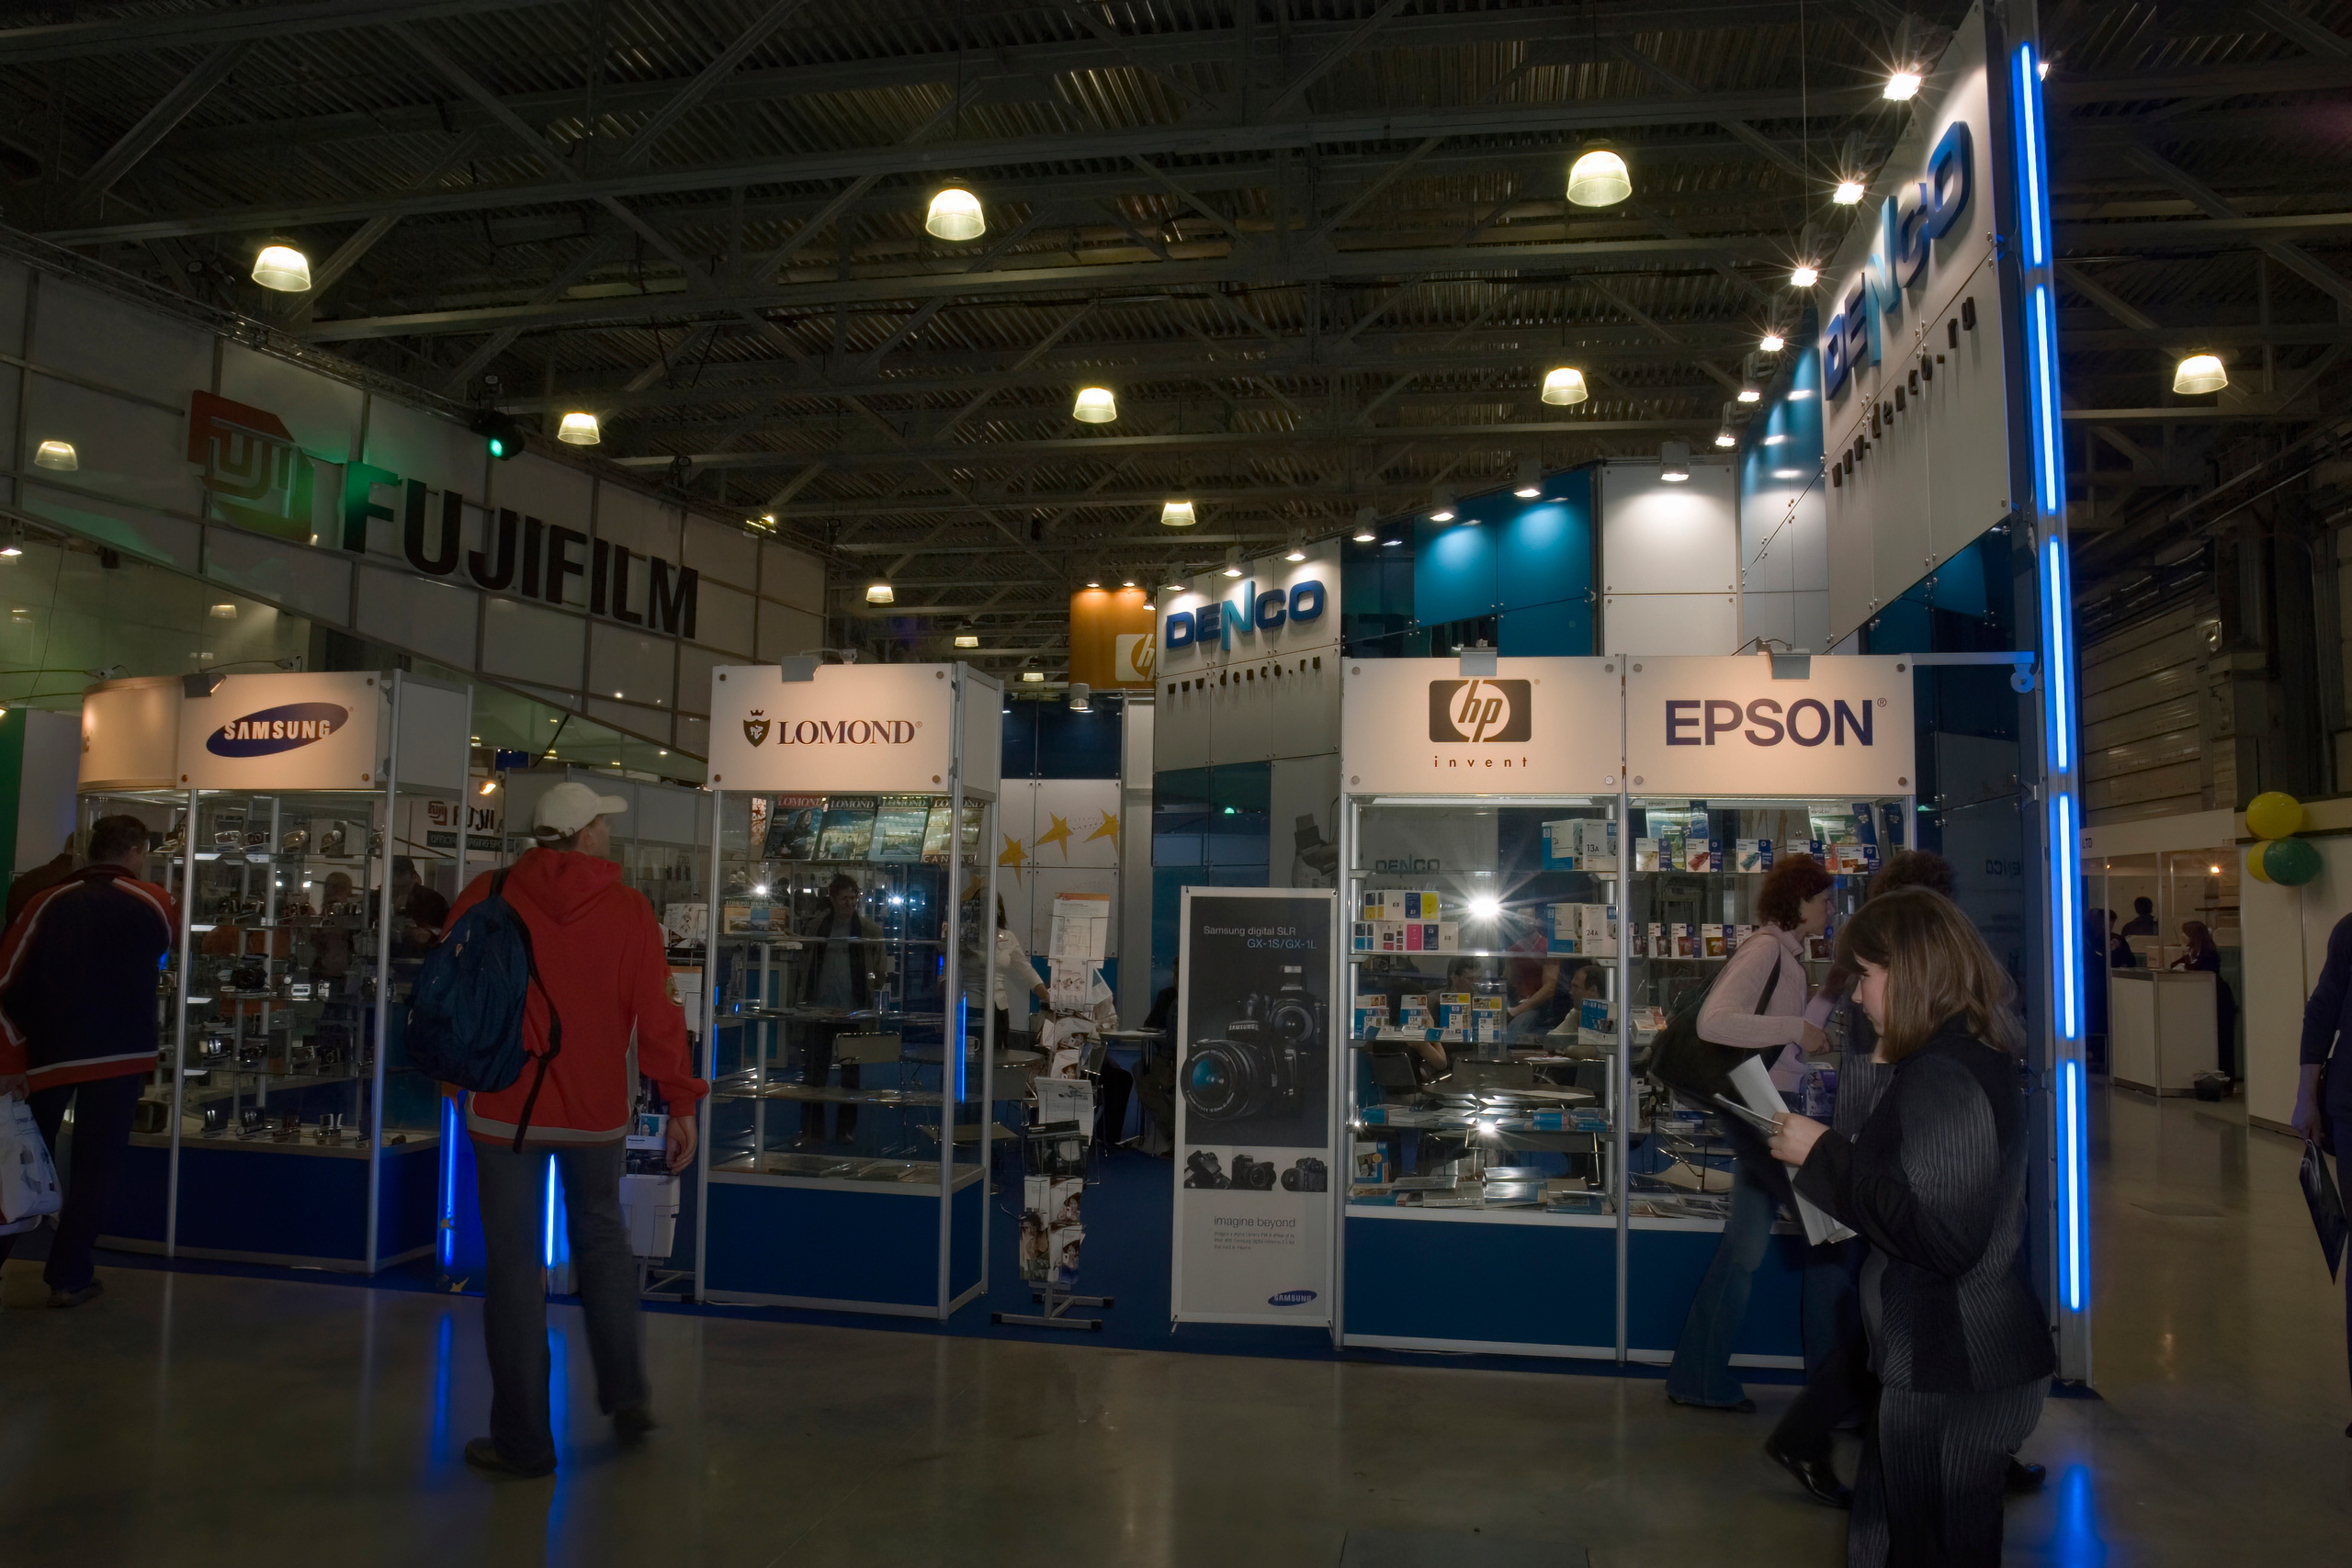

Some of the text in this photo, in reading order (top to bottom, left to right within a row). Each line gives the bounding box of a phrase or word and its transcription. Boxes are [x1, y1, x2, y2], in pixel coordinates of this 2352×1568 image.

[1825, 120, 1974, 401] DENCO
[1832, 297, 1975, 488] www.denco.ru
[344, 461, 698, 639] FUJIFILM
[1166, 581, 1325, 651] DENCO
[1168, 656, 1321, 694] www.denco.ru
[1457, 680, 1503, 742] hp
[223, 719, 331, 740] SAMSUNG
[1666, 698, 1873, 748] EPSON
[777, 720, 915, 745] LOMOND
[1434, 755, 1527, 768] invent
[831, 799, 874, 809] LOMOND
[882, 798, 927, 808] LOMOND
[1587, 844, 1600, 852] 13A
[922, 854, 974, 863] CANAS
[1203, 925, 1297, 938] Samsung digital SLR
[1247, 938, 1317, 950] GX-1S/GX-1L
[1228, 1023, 1259, 1032] SAMSUNG
[1214, 1215, 1296, 1230] imagine beyond
[1273, 1293, 1312, 1303] SAMSUNG
